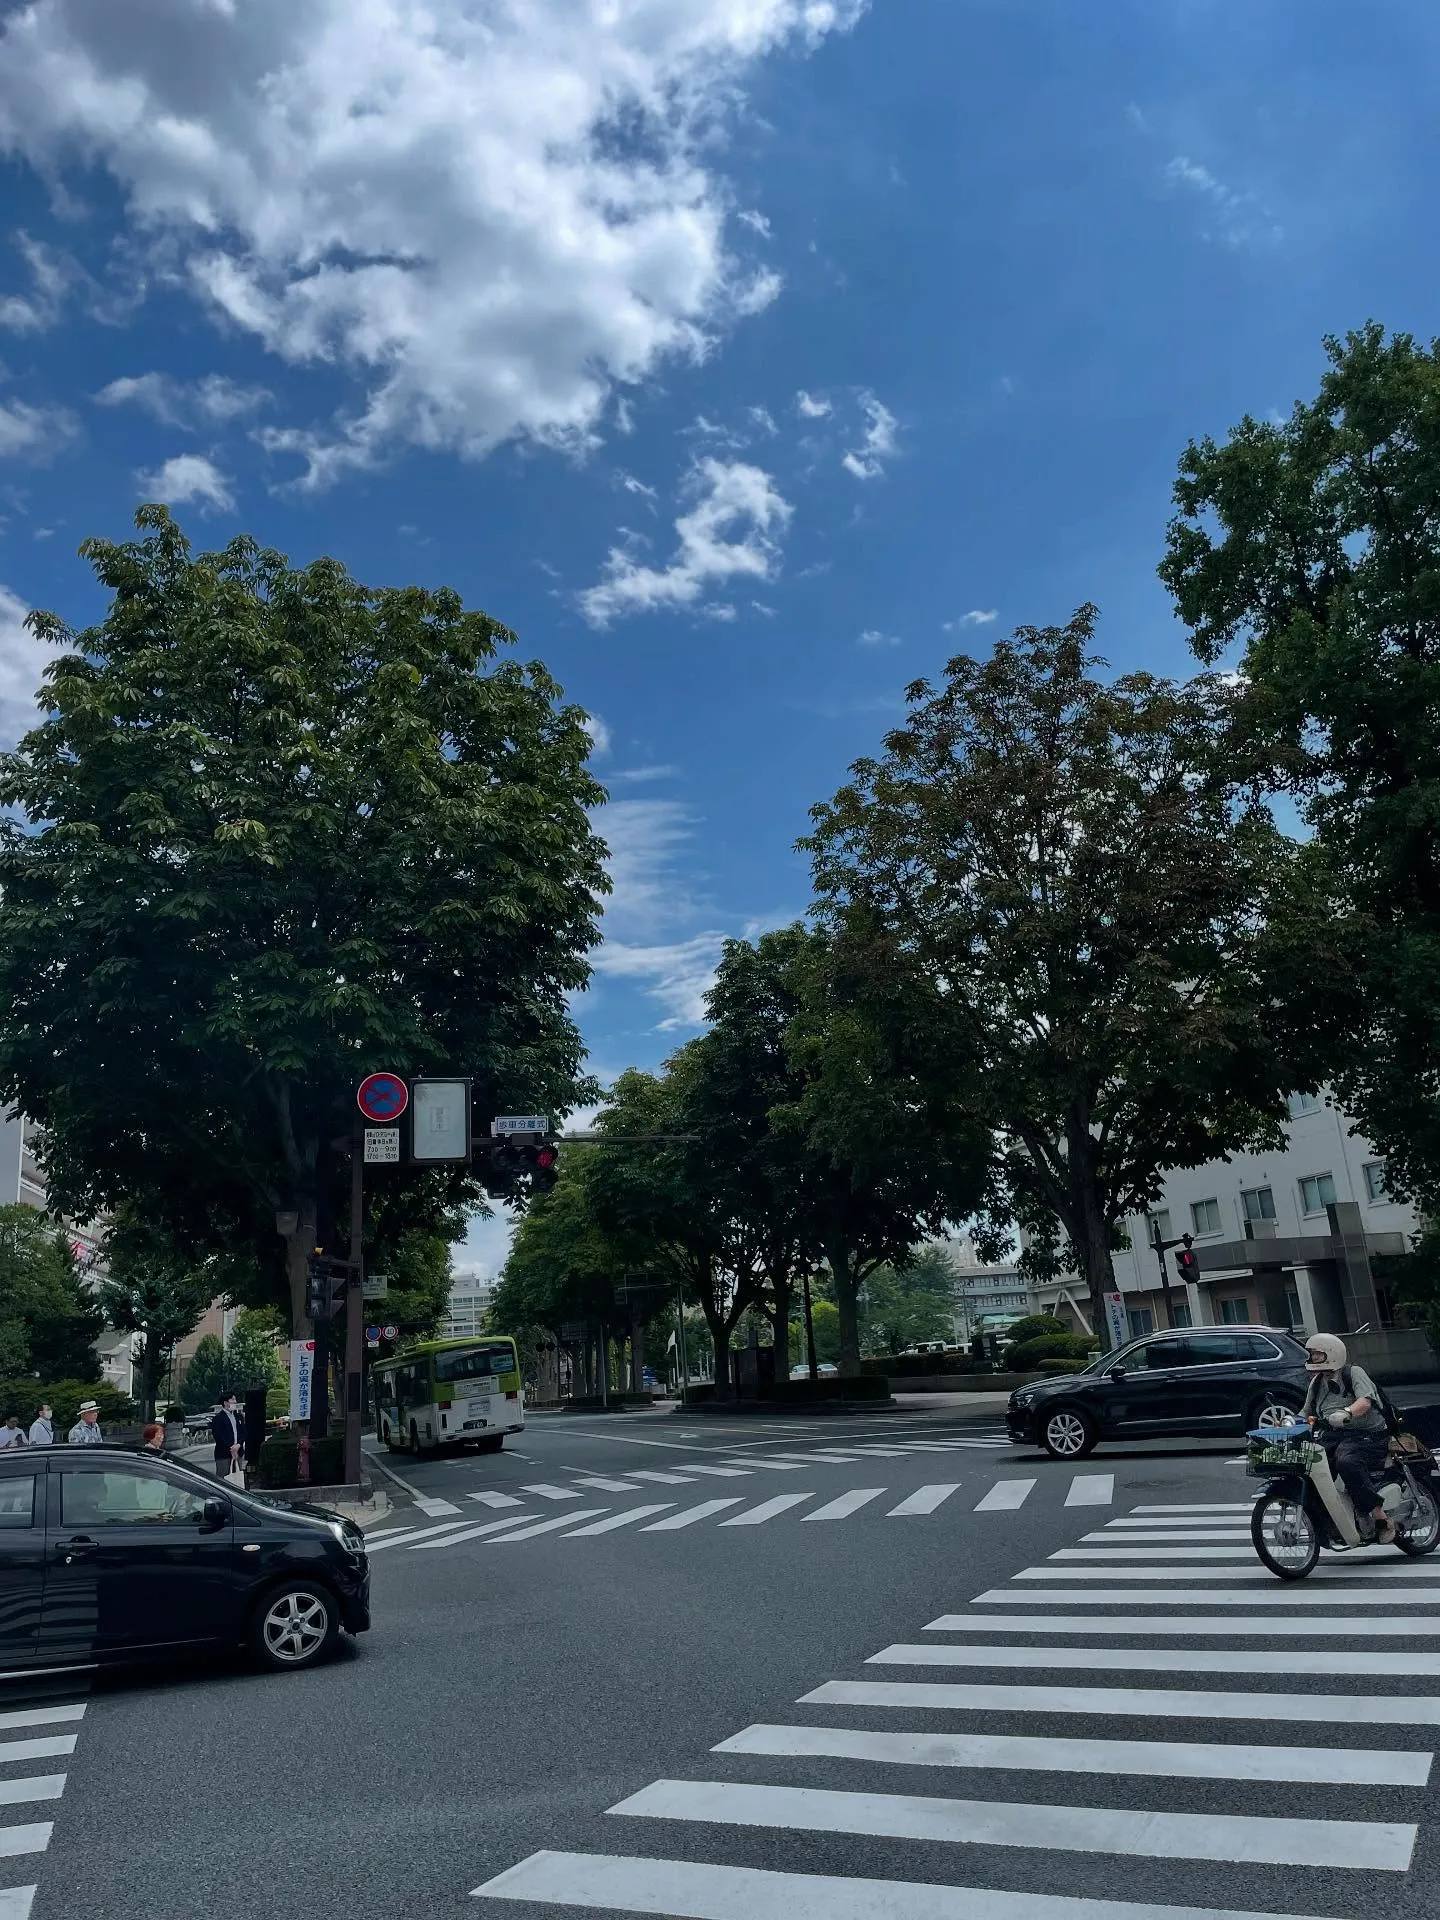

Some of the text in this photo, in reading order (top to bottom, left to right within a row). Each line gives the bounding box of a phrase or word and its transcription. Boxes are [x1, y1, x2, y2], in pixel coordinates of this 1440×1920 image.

[299, 1355, 309, 1417] トチの実が落ちます
